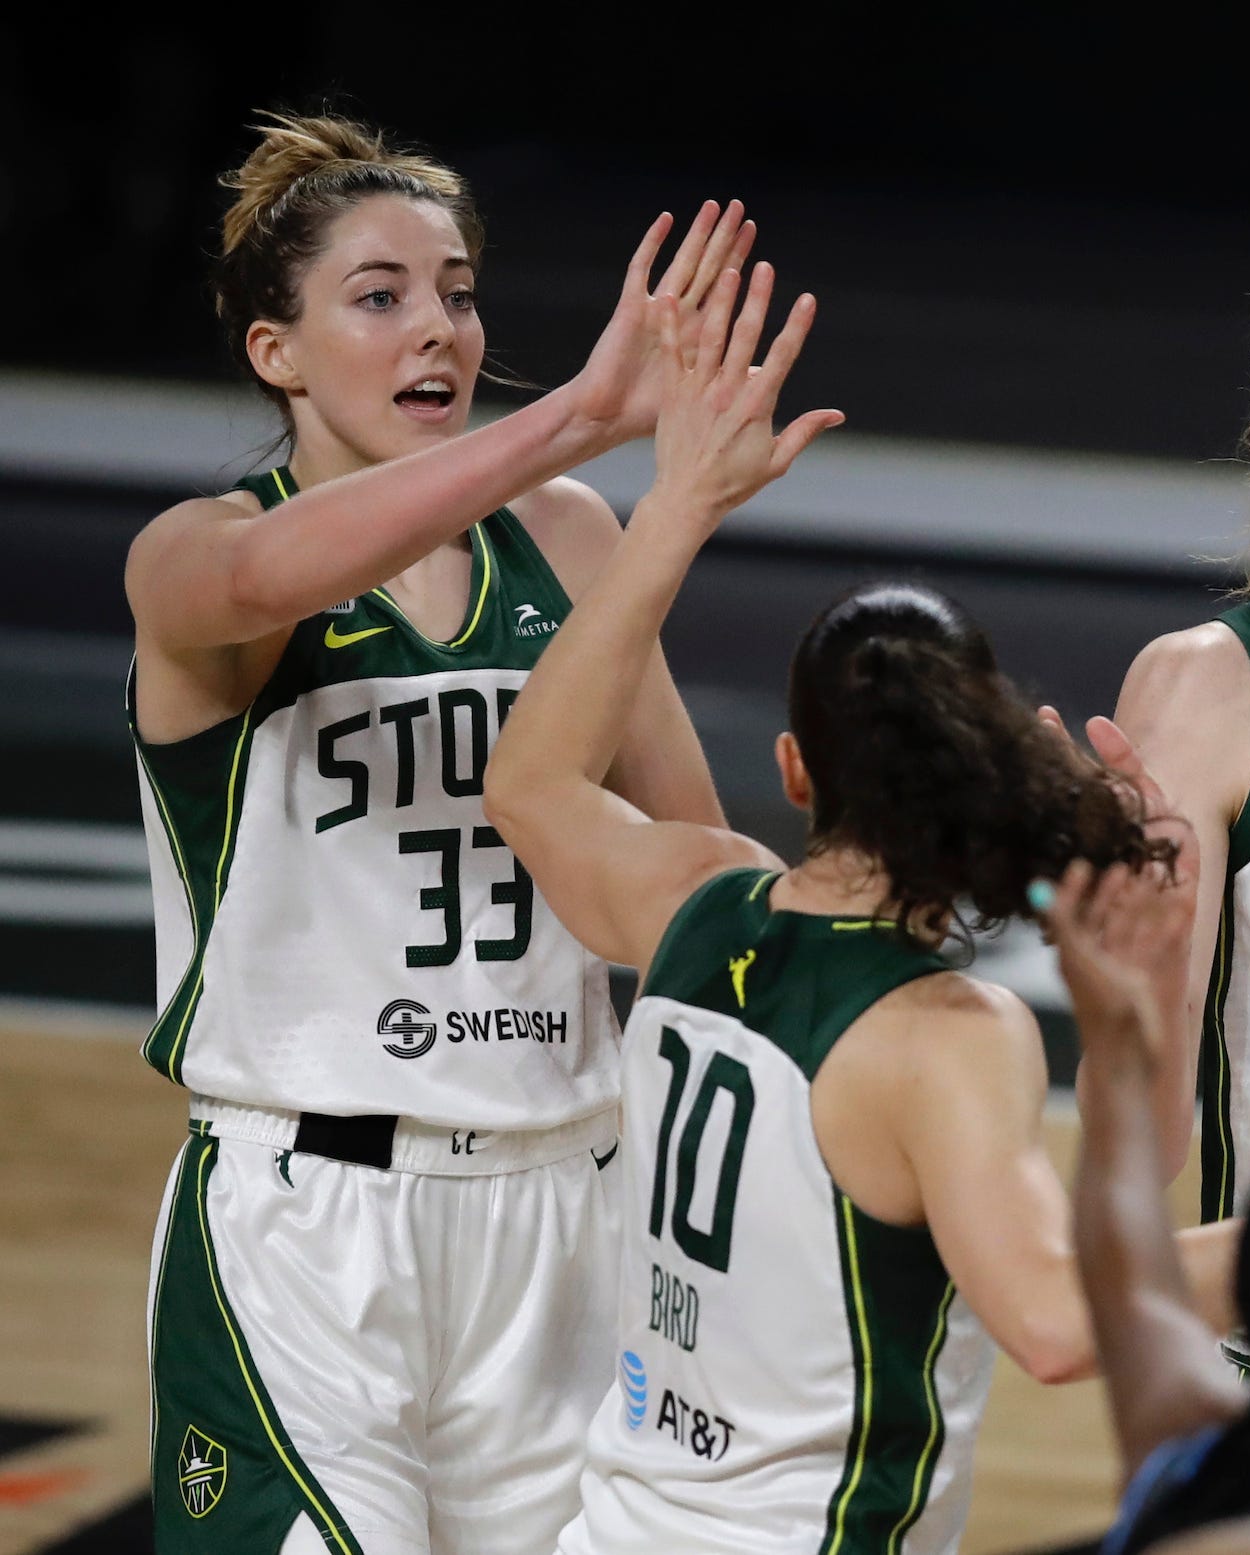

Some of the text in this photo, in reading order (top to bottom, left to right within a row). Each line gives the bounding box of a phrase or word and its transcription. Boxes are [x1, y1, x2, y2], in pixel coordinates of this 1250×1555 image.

[315, 688, 520, 833] STO
[399, 827, 533, 967] 33
[446, 1008, 567, 1043] SWEDISH
[648, 1025, 756, 1273] 10
[649, 1263, 699, 1352] BIRD
[656, 1388, 736, 1462] AT&T
